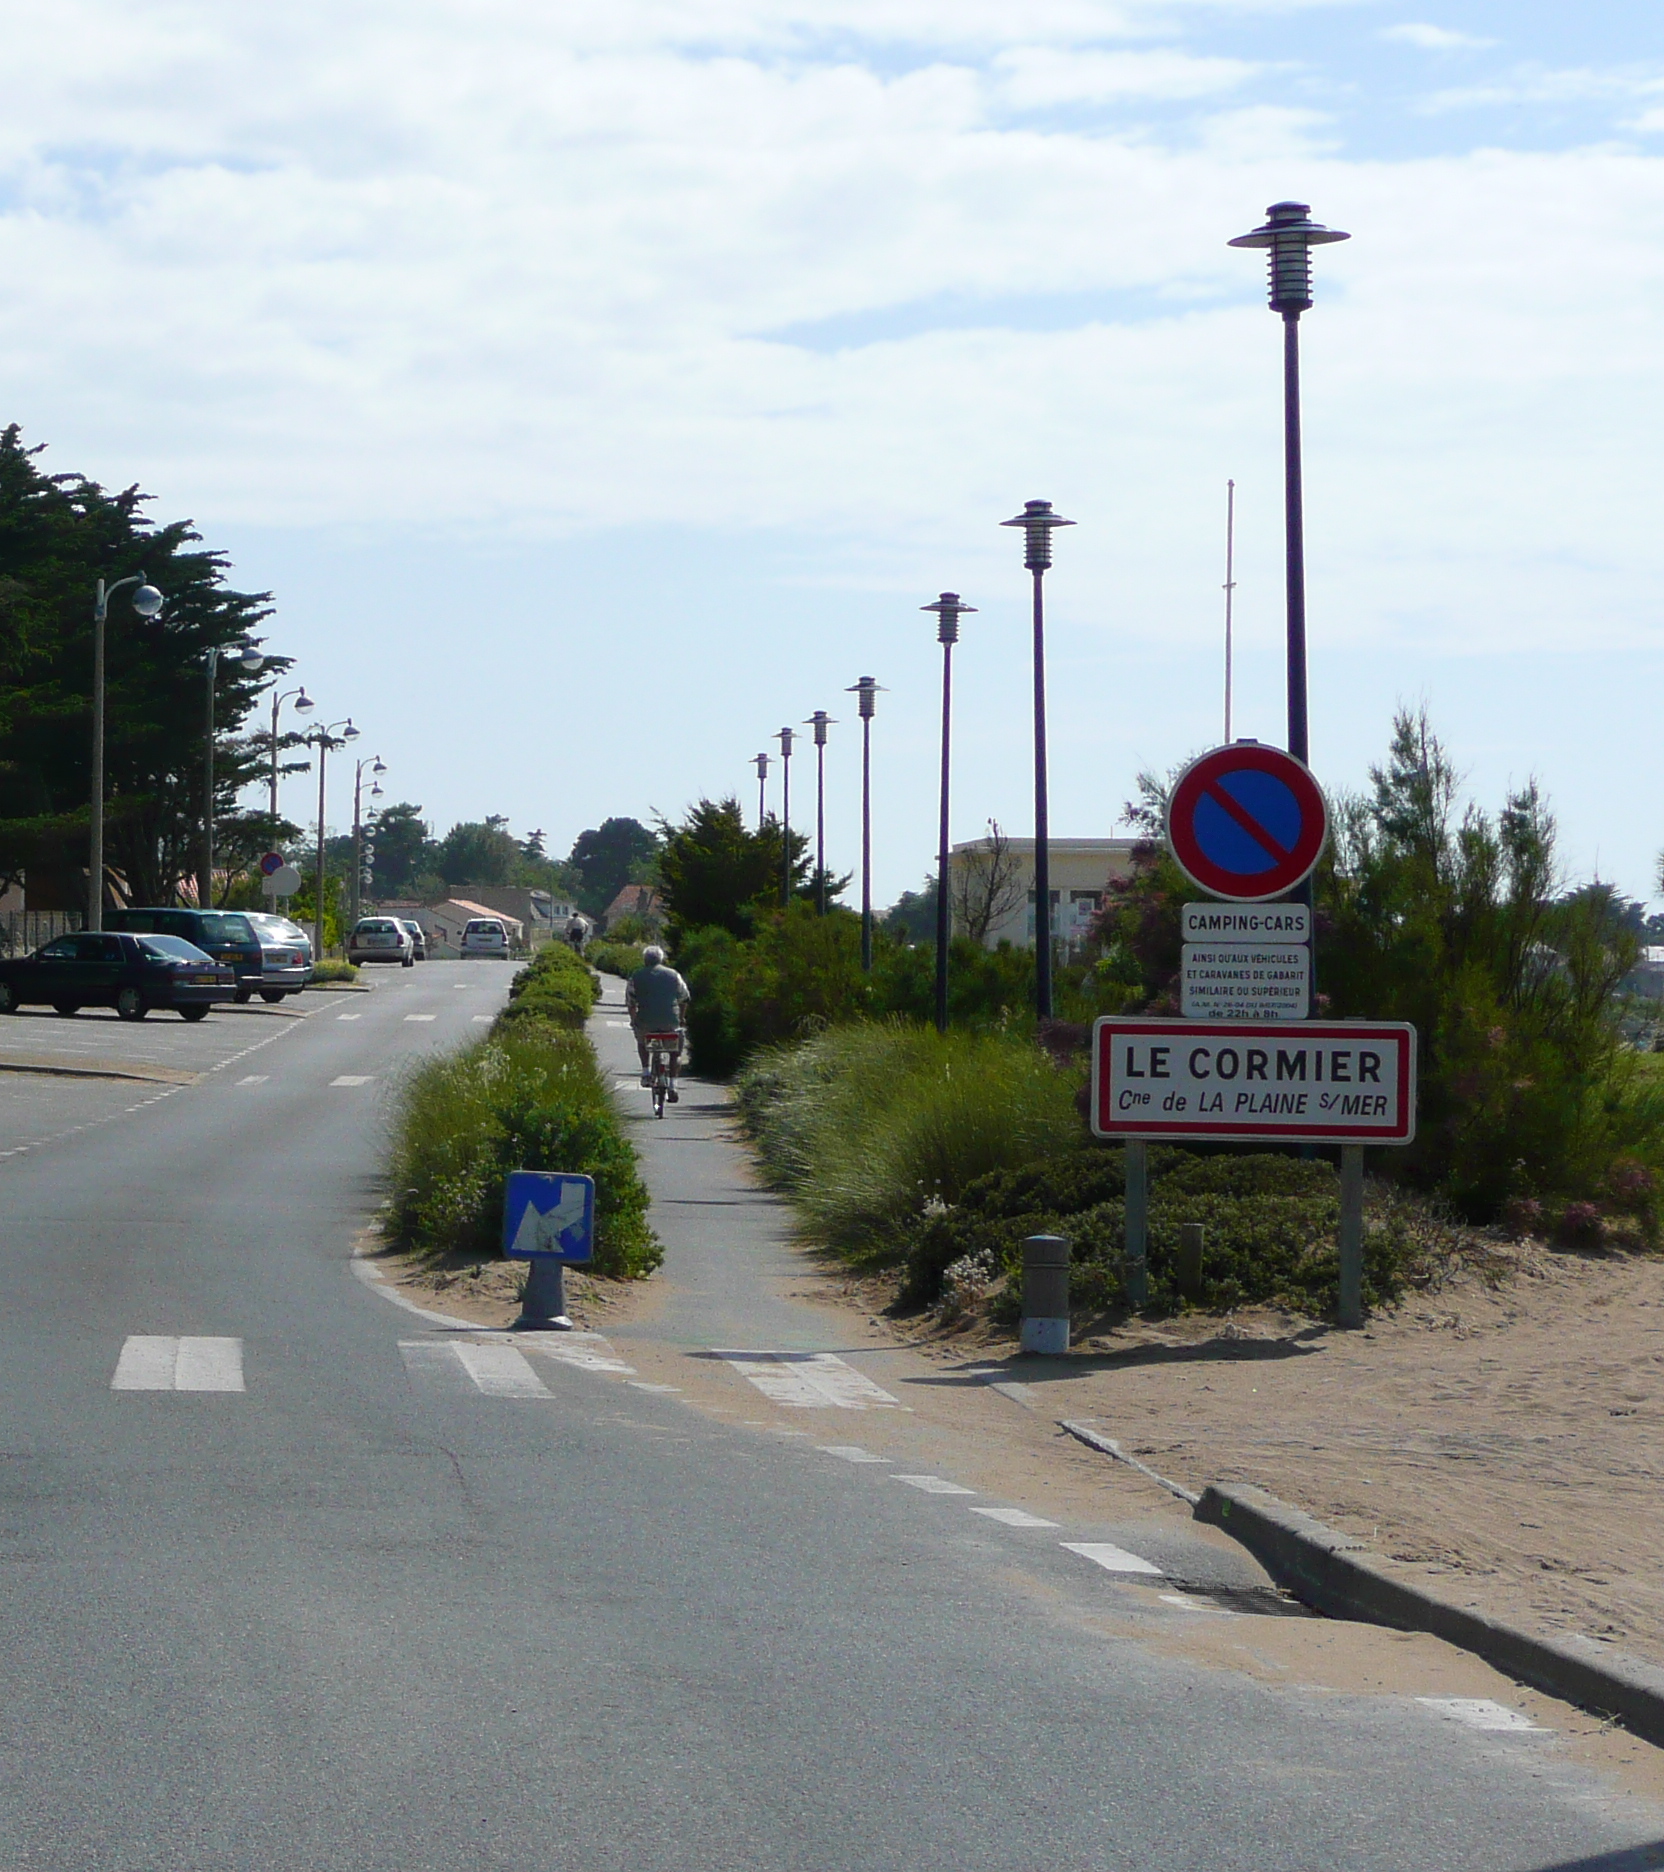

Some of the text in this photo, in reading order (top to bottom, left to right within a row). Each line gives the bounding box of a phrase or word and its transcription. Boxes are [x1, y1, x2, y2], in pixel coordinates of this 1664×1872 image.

[1188, 914, 1305, 931] CAMPING-CARS
[1192, 953, 1216, 963] AINSI
[1218, 953, 1249, 964] QU'AUX
[1187, 969, 1304, 980] ET CARAVANES DE GABARIT
[1189, 986, 1234, 995] SIMILAIRE
[1237, 986, 1249, 996] OU
[1208, 1009, 1223, 1018] de
[1227, 1009, 1249, 1018] 22h
[1263, 1009, 1279, 1018] 8h
[1126, 1046, 1382, 1083] LE CORMIER
[1162, 1090, 1187, 1112] de
[1198, 1091, 1224, 1112] LA
[1234, 1092, 1308, 1114] PLAINE
